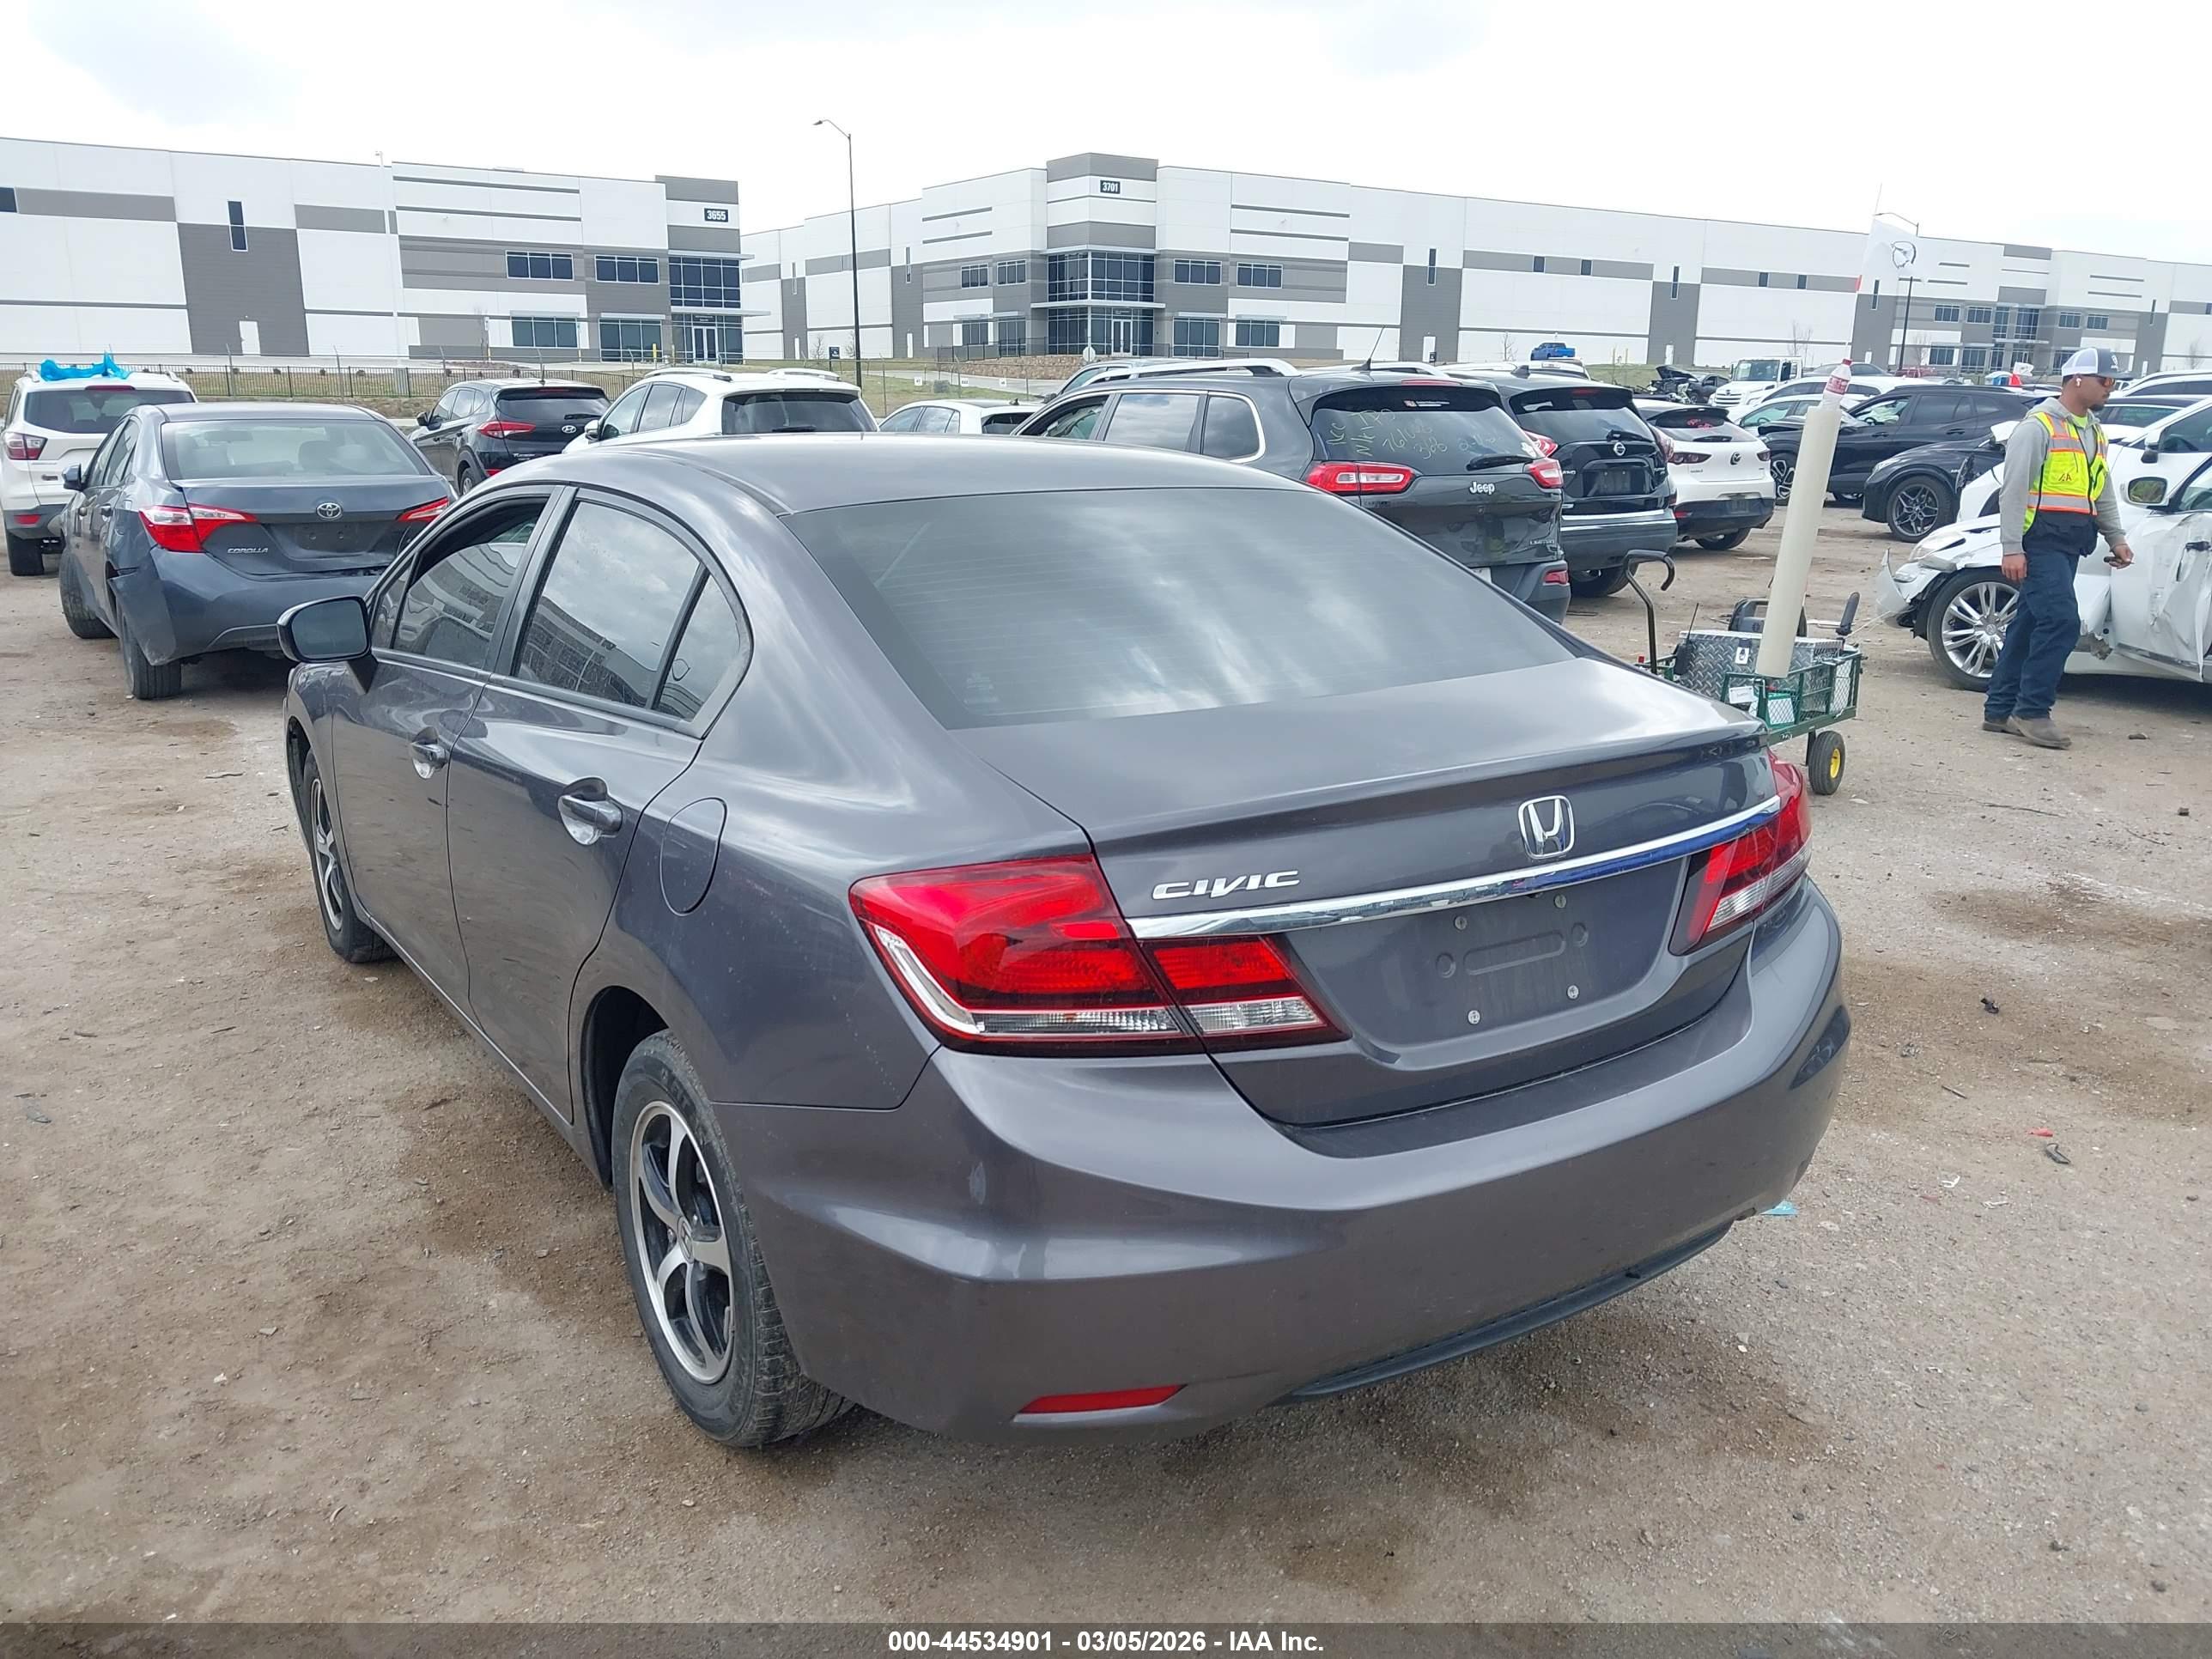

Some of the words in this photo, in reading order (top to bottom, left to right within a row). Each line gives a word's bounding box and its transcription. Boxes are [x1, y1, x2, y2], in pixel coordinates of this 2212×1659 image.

[1103, 182, 1119, 192] 3701
[1469, 481, 1496, 495] Jeep
[1152, 870, 1301, 900] CIVIC
